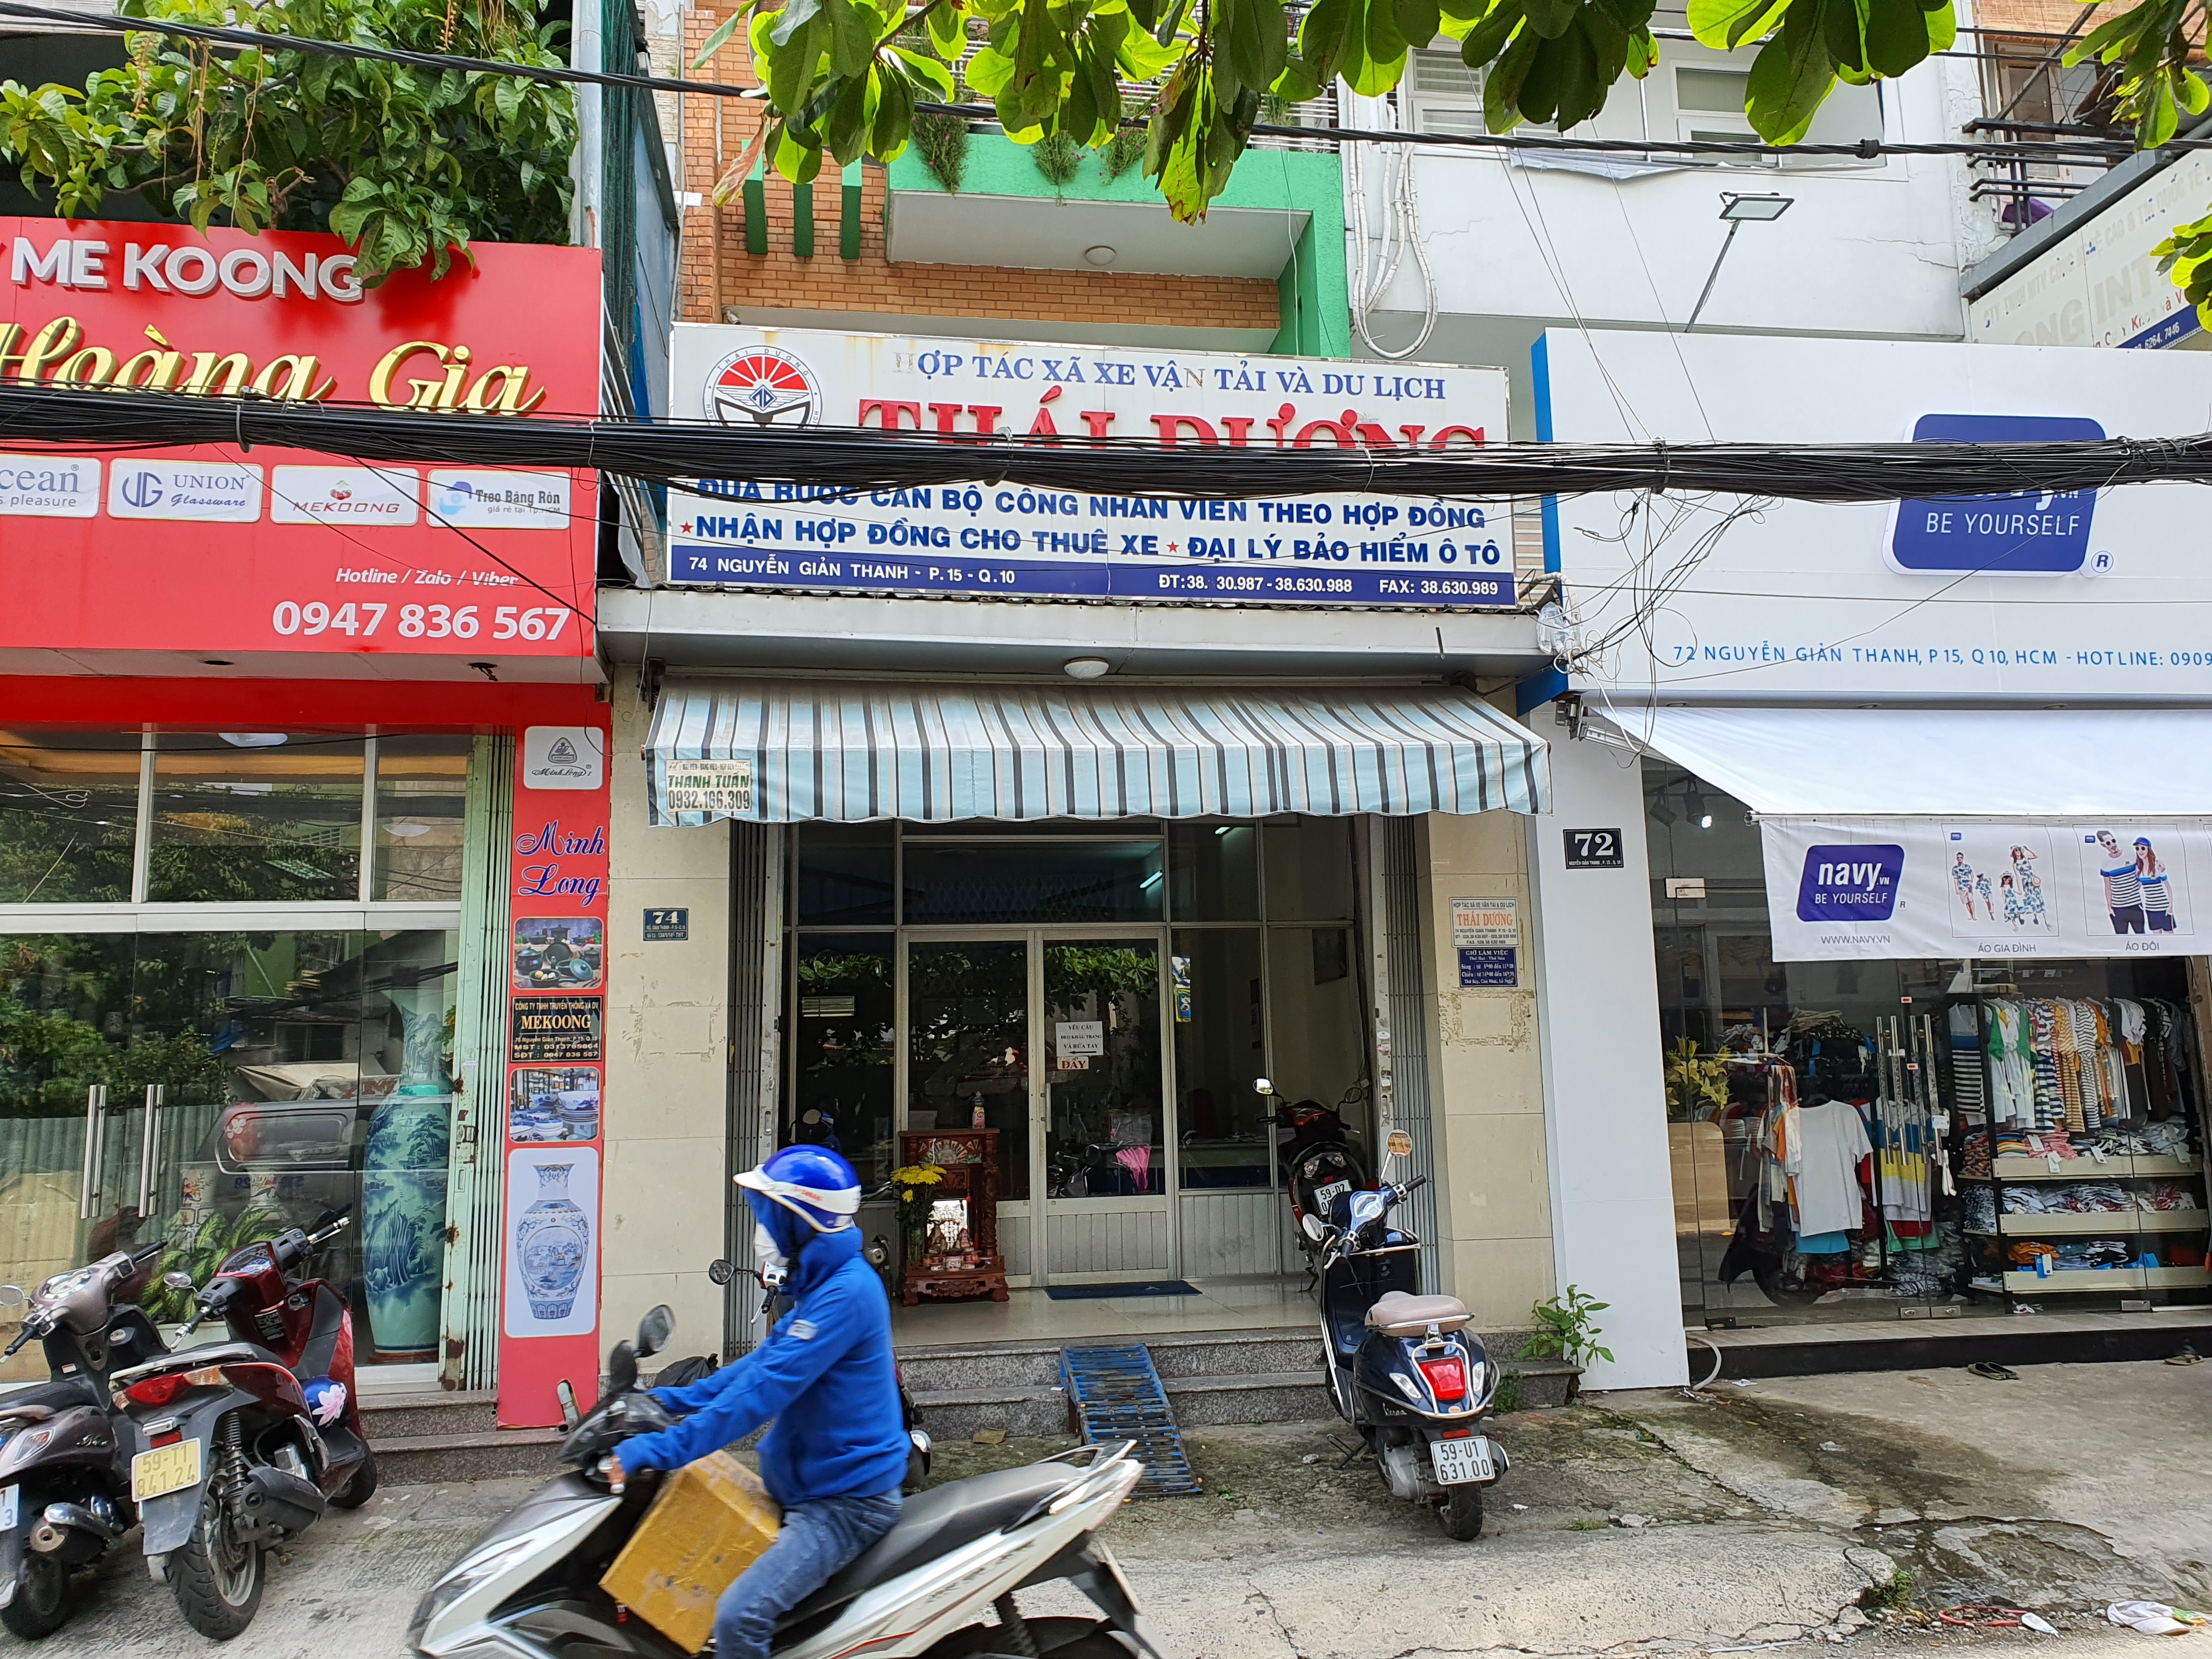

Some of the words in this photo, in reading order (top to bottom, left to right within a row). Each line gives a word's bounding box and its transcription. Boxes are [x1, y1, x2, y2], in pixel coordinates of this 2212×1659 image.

[11, 237, 109, 289] ME
[123, 242, 363, 302] KOONG
[369, 341, 544, 415] Gia
[972, 351, 1033, 379] TÁC
[1042, 357, 1086, 383] XÃ
[1094, 362, 1135, 385] XE
[1143, 360, 1205, 392] VẬN
[1215, 360, 1266, 391] TẢI
[1276, 366, 1313, 393] VÀ
[1323, 374, 1364, 396] DU
[1374, 376, 1446, 401] LỊCH
[173, 474, 244, 490] UNION
[10, 494, 76, 507] pleasure
[171, 493, 246, 507] Glassware
[476, 489, 501, 503] Treo
[506, 489, 534, 505] Băng
[538, 489, 560, 504] Rôn
[292, 501, 400, 514] MEKOONG
[488, 506, 500, 515] giá
[514, 506, 526, 515] tại
[943, 485, 982, 517] BỘ
[996, 488, 1078, 516] CÔNG
[1258, 503, 1331, 524] THEO
[1343, 501, 1398, 531] HỢP
[1408, 499, 1485, 528] ĐỒNG
[1926, 512, 1953, 534] BE
[1965, 513, 2080, 536] YOURSELF
[696, 512, 782, 544] NHẬN
[795, 517, 856, 549] HỢP
[867, 517, 950, 548] ĐỒNG
[960, 527, 1021, 551] CHO
[1032, 528, 1108, 555] THUÊ
[1120, 534, 1159, 555] XE
[1188, 537, 1235, 563] ĐẠI
[1248, 533, 1283, 558] LÝ
[1294, 532, 1349, 561] BẢO
[1361, 532, 1427, 562] HIỂM
[1438, 538, 1457, 563] Ô
[1465, 539, 1500, 565] TÔ
[689, 556, 708, 571] 74
[718, 553, 789, 574] NGUYỄN
[799, 556, 840, 577] GIẢN
[850, 563, 909, 579] THANH
[336, 568, 398, 584] Hotline
[414, 569, 452, 585] Zalo
[472, 570, 519, 586] Viber
[1275, 577, 1352, 593] 38.630.988
[1379, 579, 1415, 594] FAX:
[1420, 581, 1498, 595] 38.630.989
[273, 601, 387, 636] 0947
[398, 604, 479, 638] 836
[493, 606, 570, 640] 567
[1673, 646, 1696, 661] 72
[1705, 640, 1785, 661] NGUYỄN
[1796, 642, 1842, 662] GIẢN
[1852, 648, 1922, 666] THANH,
[2016, 650, 2057, 664] HCM
[2077, 651, 2163, 665] HOTLINE:
[668, 775, 711, 788] THANH
[716, 771, 750, 788] TUẤN
[669, 790, 750, 809] 0932.166.309
[515, 820, 605, 856] Minh
[1575, 833, 1613, 856] 72
[518, 864, 601, 907] Long
[1818, 862, 1889, 891] navy.VN
[1815, 893, 1827, 904] BE
[1832, 893, 1888, 904] YOURSELF
[652, 911, 680, 924] 74
[1457, 911, 1480, 926] THÁI
[1483, 911, 1513, 926] DƯƠNG
[1820, 935, 1891, 944] WWW.NAVY.VN
[1978, 942, 1991, 953] ÁO
[1994, 944, 2009, 953] GIA
[2012, 943, 2036, 953] ĐÌNH
[2125, 940, 2140, 951] ÁO
[2142, 940, 2160, 951] ĐÔI
[521, 1014, 591, 1030] MEKOONG
[1062, 1056, 1086, 1069] ĐẨY
[143, 1444, 187, 1474] 59-T1
[1440, 1441, 1480, 1461] 59-U1
[137, 1463, 195, 1496] 841.24
[1440, 1459, 1489, 1481] 631.00
